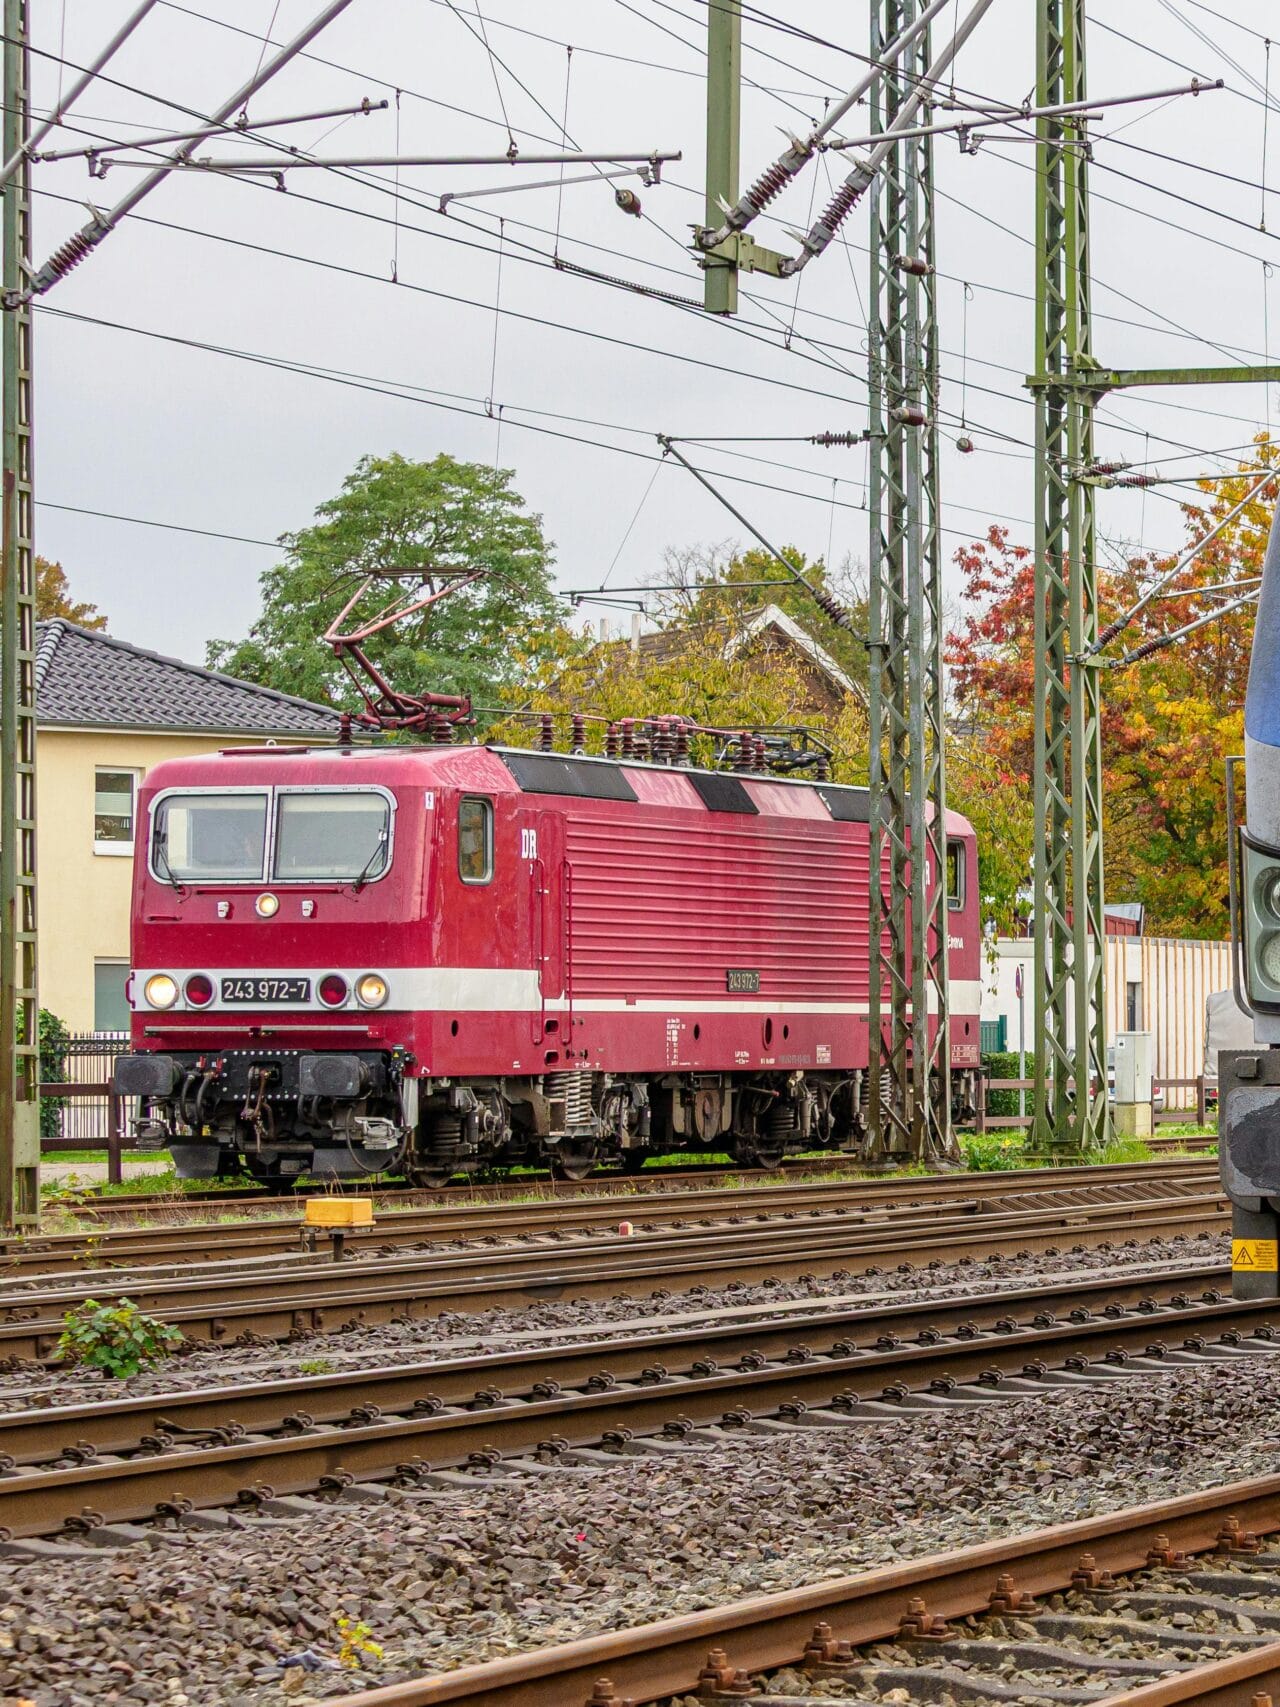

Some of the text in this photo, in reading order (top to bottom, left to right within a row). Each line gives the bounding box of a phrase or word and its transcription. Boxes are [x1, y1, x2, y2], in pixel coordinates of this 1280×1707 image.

[521, 828, 537, 859] DR
[224, 981, 307, 999] 243 972-7
